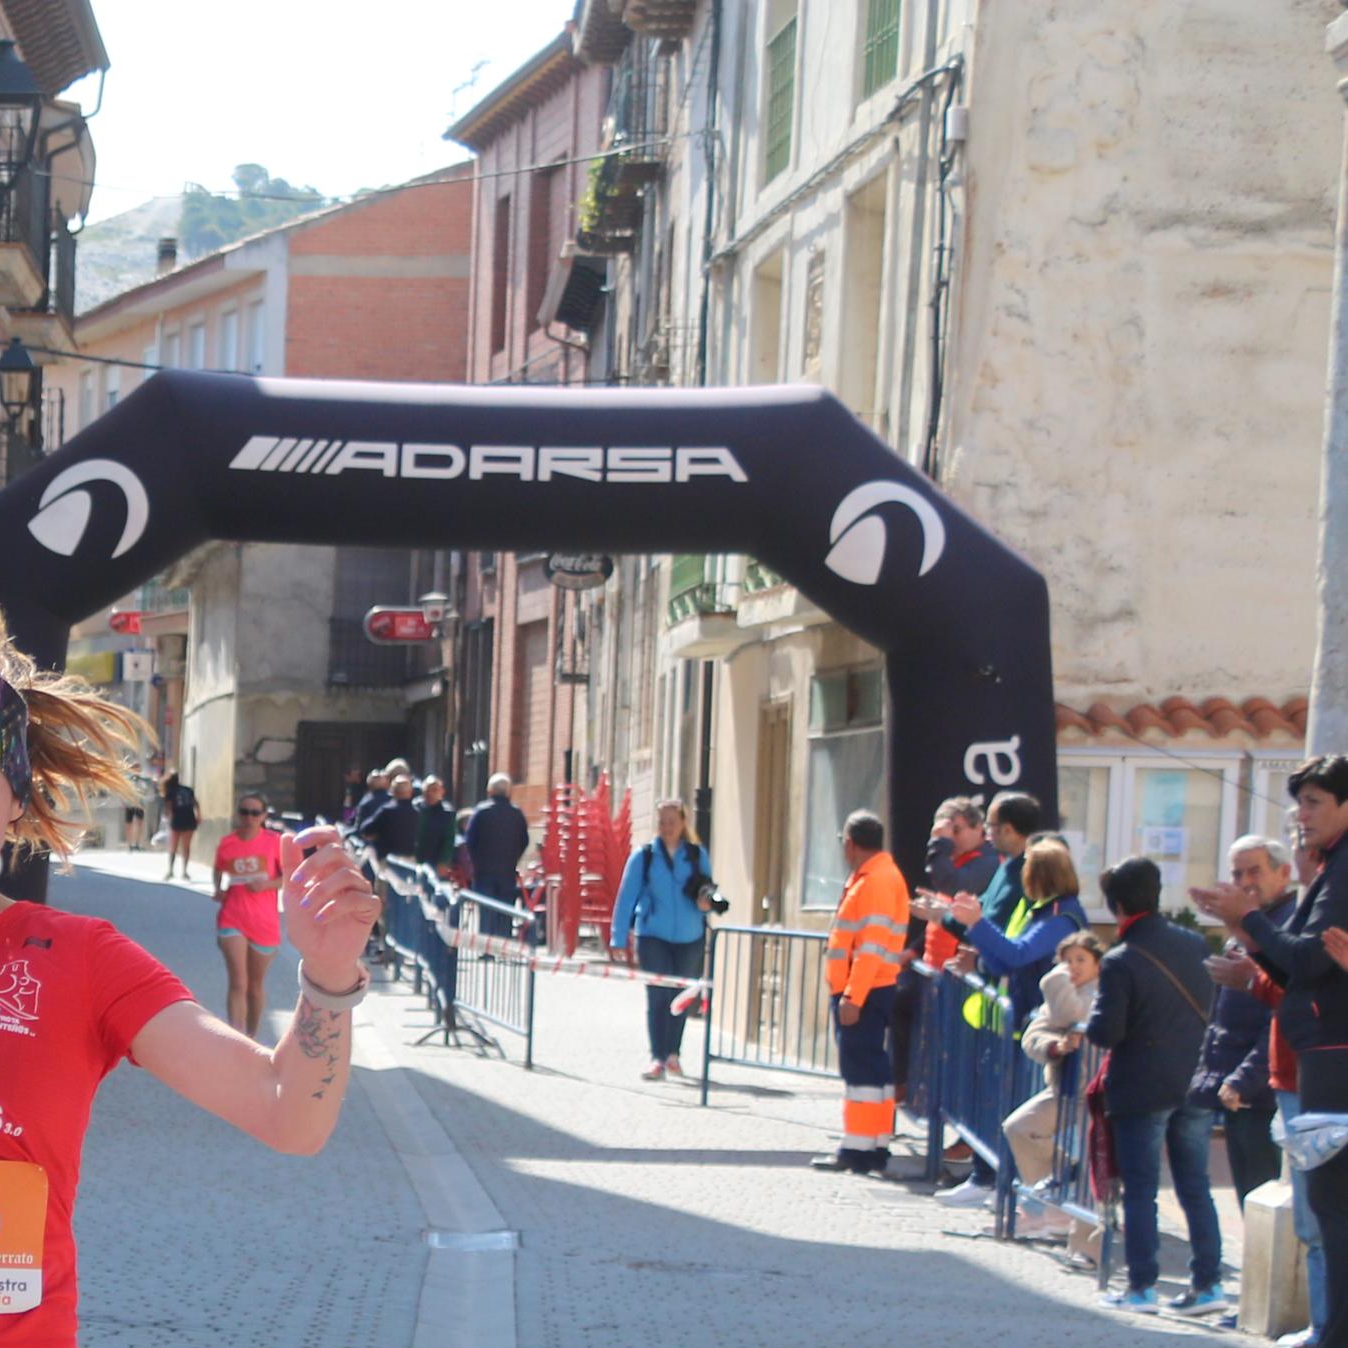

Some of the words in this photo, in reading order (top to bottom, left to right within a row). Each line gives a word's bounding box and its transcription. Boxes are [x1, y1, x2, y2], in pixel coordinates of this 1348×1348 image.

[324, 440, 749, 483] ADARSA
[234, 856, 259, 873] 63
[3, 1123, 23, 1137] 3.0
